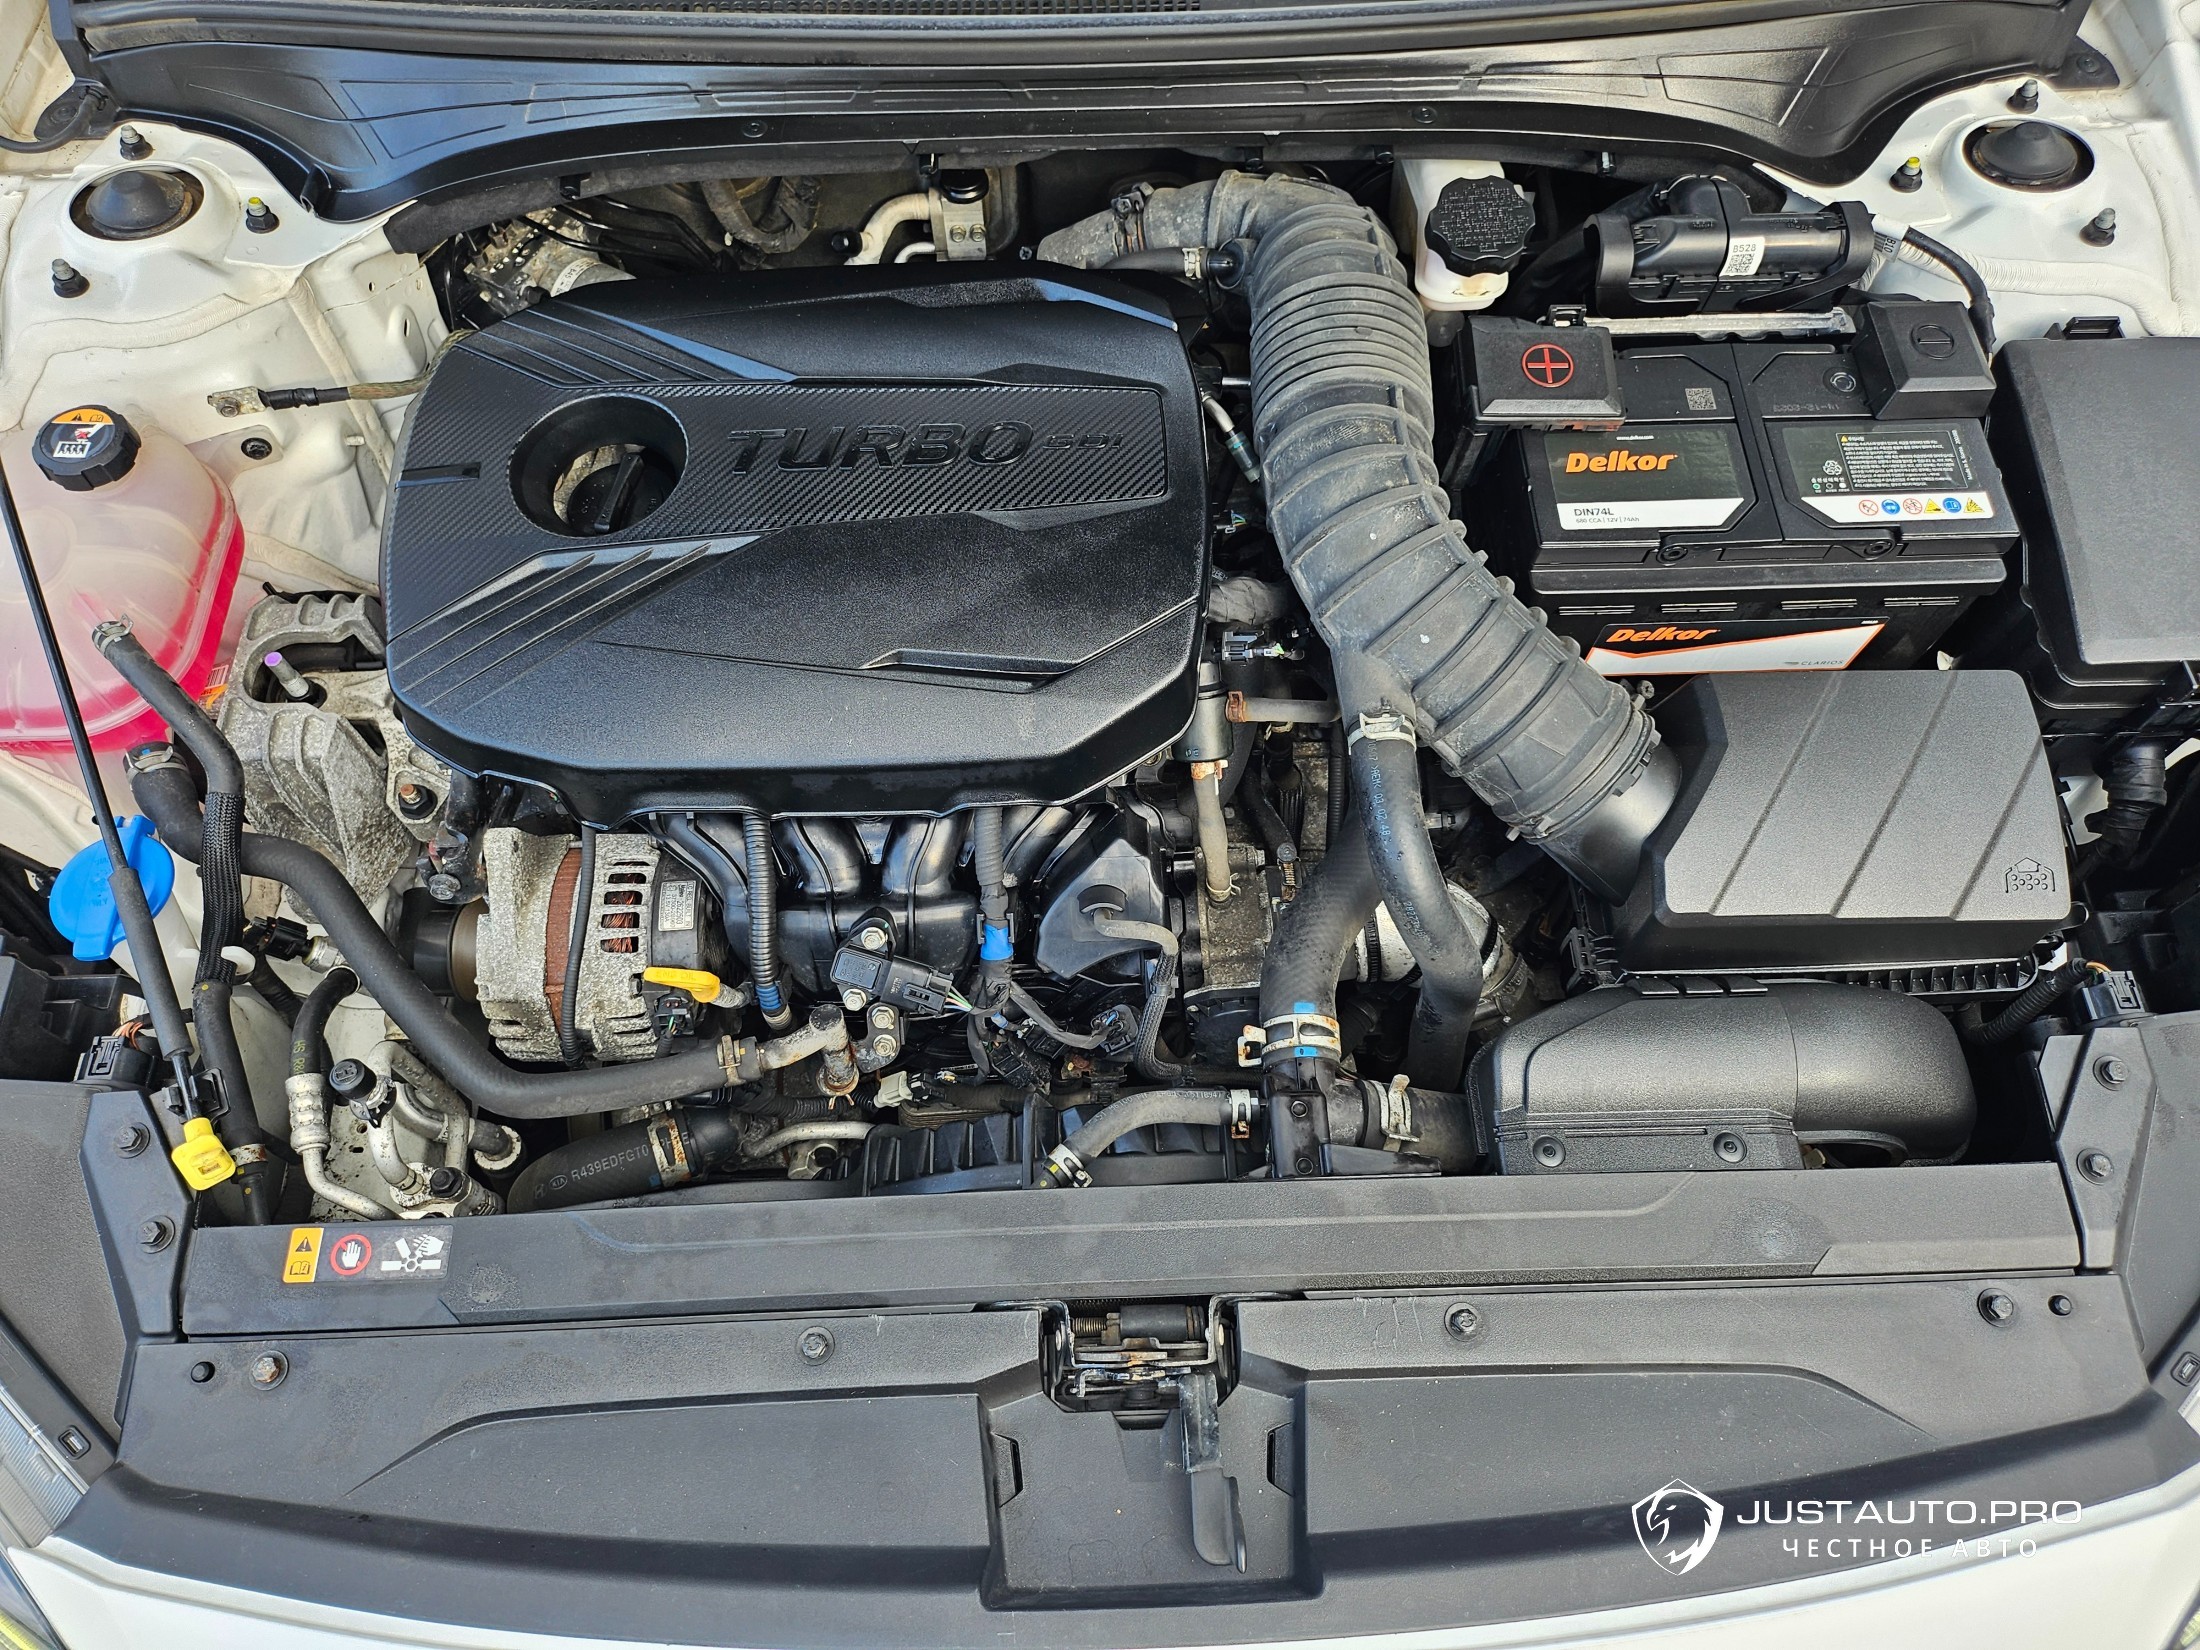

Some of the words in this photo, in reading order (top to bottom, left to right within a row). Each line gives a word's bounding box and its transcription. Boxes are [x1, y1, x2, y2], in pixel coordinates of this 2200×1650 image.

[727, 421, 1034, 475] TURBO
[1565, 450, 1676, 473] Delkor
[1573, 507, 1615, 517] DIN74L
[1606, 626, 1718, 643] Delkor
[550, 1176, 567, 1189] KIA
